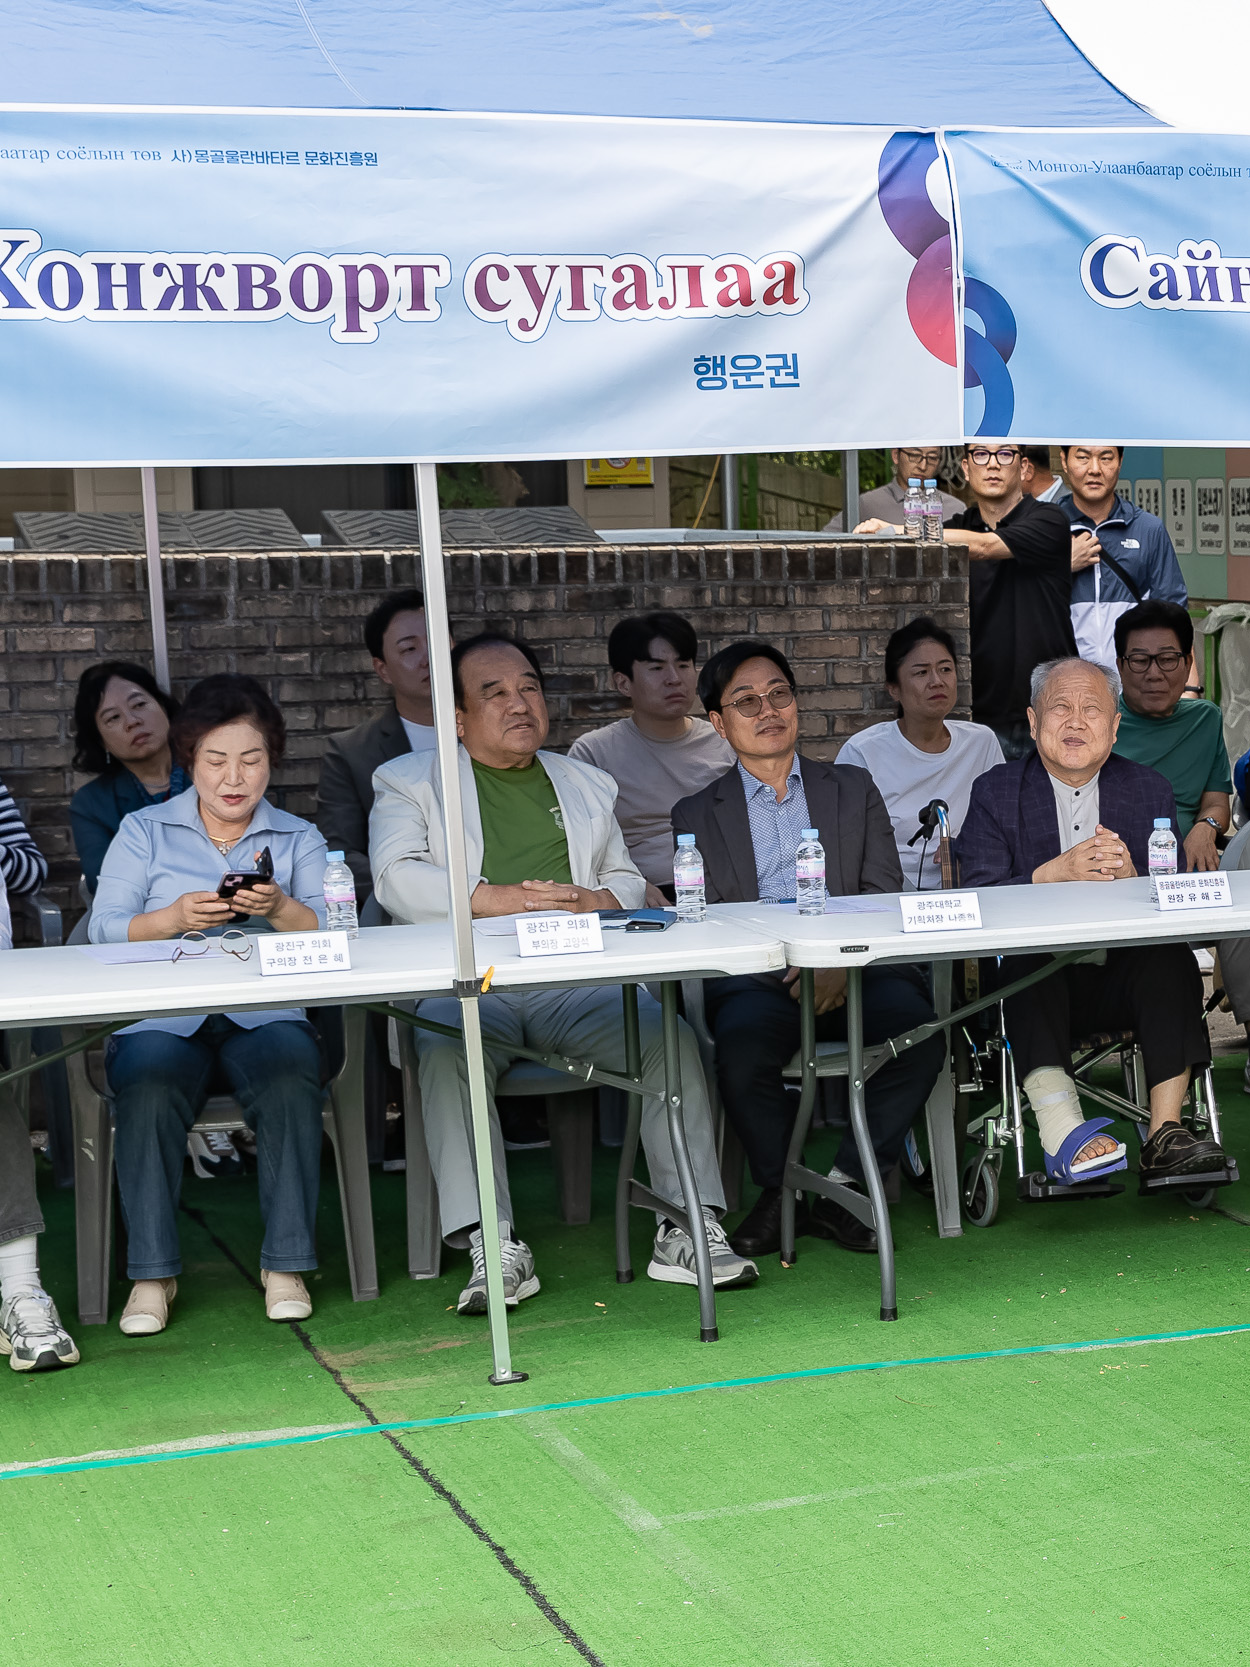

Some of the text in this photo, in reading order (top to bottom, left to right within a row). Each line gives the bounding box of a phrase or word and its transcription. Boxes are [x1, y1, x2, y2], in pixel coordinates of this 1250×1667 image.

[0, 145, 162, 163] аатар соёлын төв
[304, 151, 379, 167] 문화진흥원
[1027, 159, 1184, 180] Монгол-Улаанбаатар
[1188, 162, 1242, 178] соёлын
[473, 260, 801, 332] сугалаа
[693, 352, 801, 391] 행운권
[1167, 893, 1184, 903] 원장
[1188, 893, 1197, 902] 유
[1213, 891, 1222, 900] 근
[916, 899, 961, 911] 광주대학교
[526, 918, 590, 934] 광진구 의회
[908, 914, 944, 925] 기획처장
[275, 938, 332, 952] 광진구 의회
[532, 939, 558, 950] 부의장
[266, 956, 297, 968] 구의장
[318, 954, 328, 964] 은
